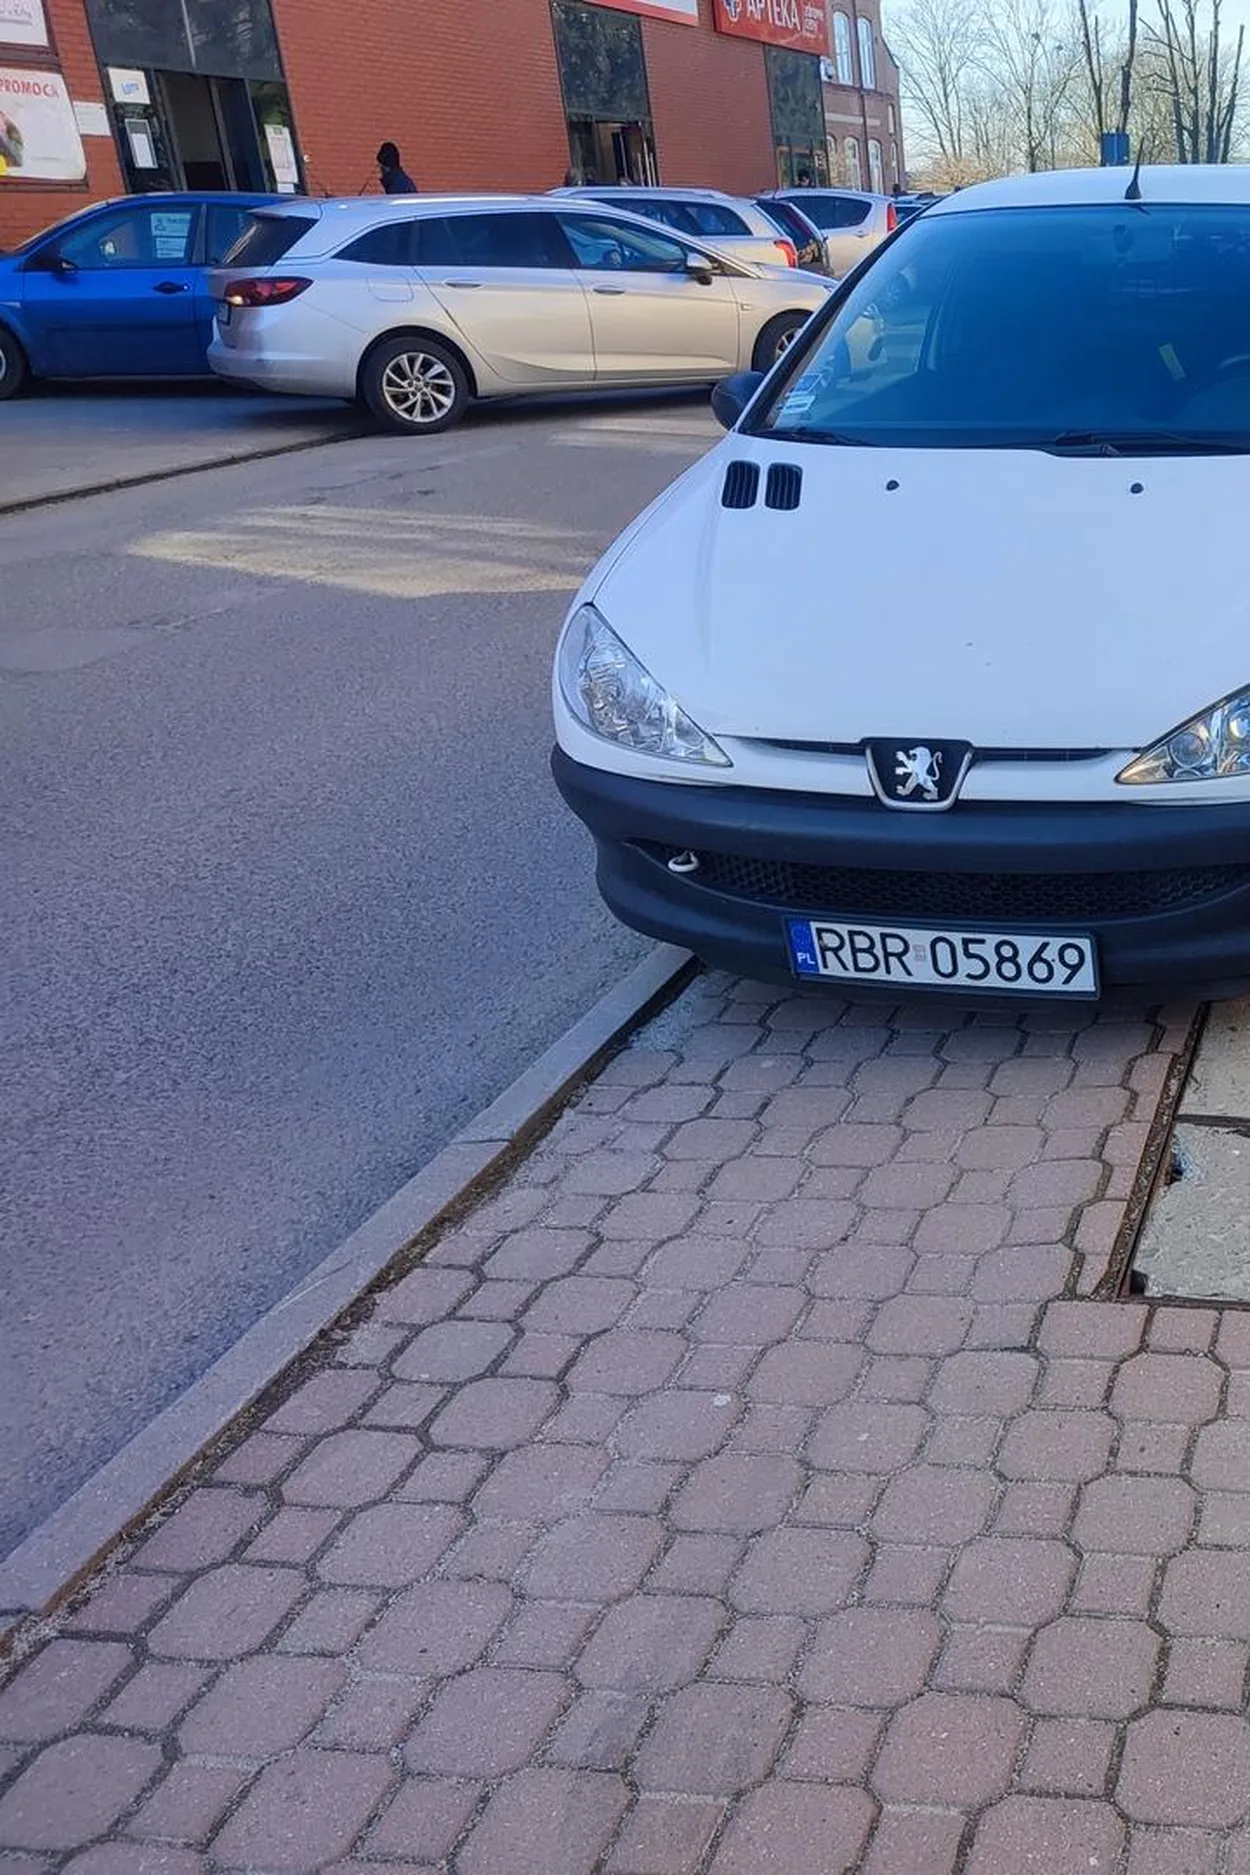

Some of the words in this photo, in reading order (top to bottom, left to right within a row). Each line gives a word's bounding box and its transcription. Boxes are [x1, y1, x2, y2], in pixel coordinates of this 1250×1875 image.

[746, 0, 801, 31] APTEKA
[797, 952, 816, 965] PL
[815, 926, 913, 977] RBR
[929, 935, 1086, 986] 05869
